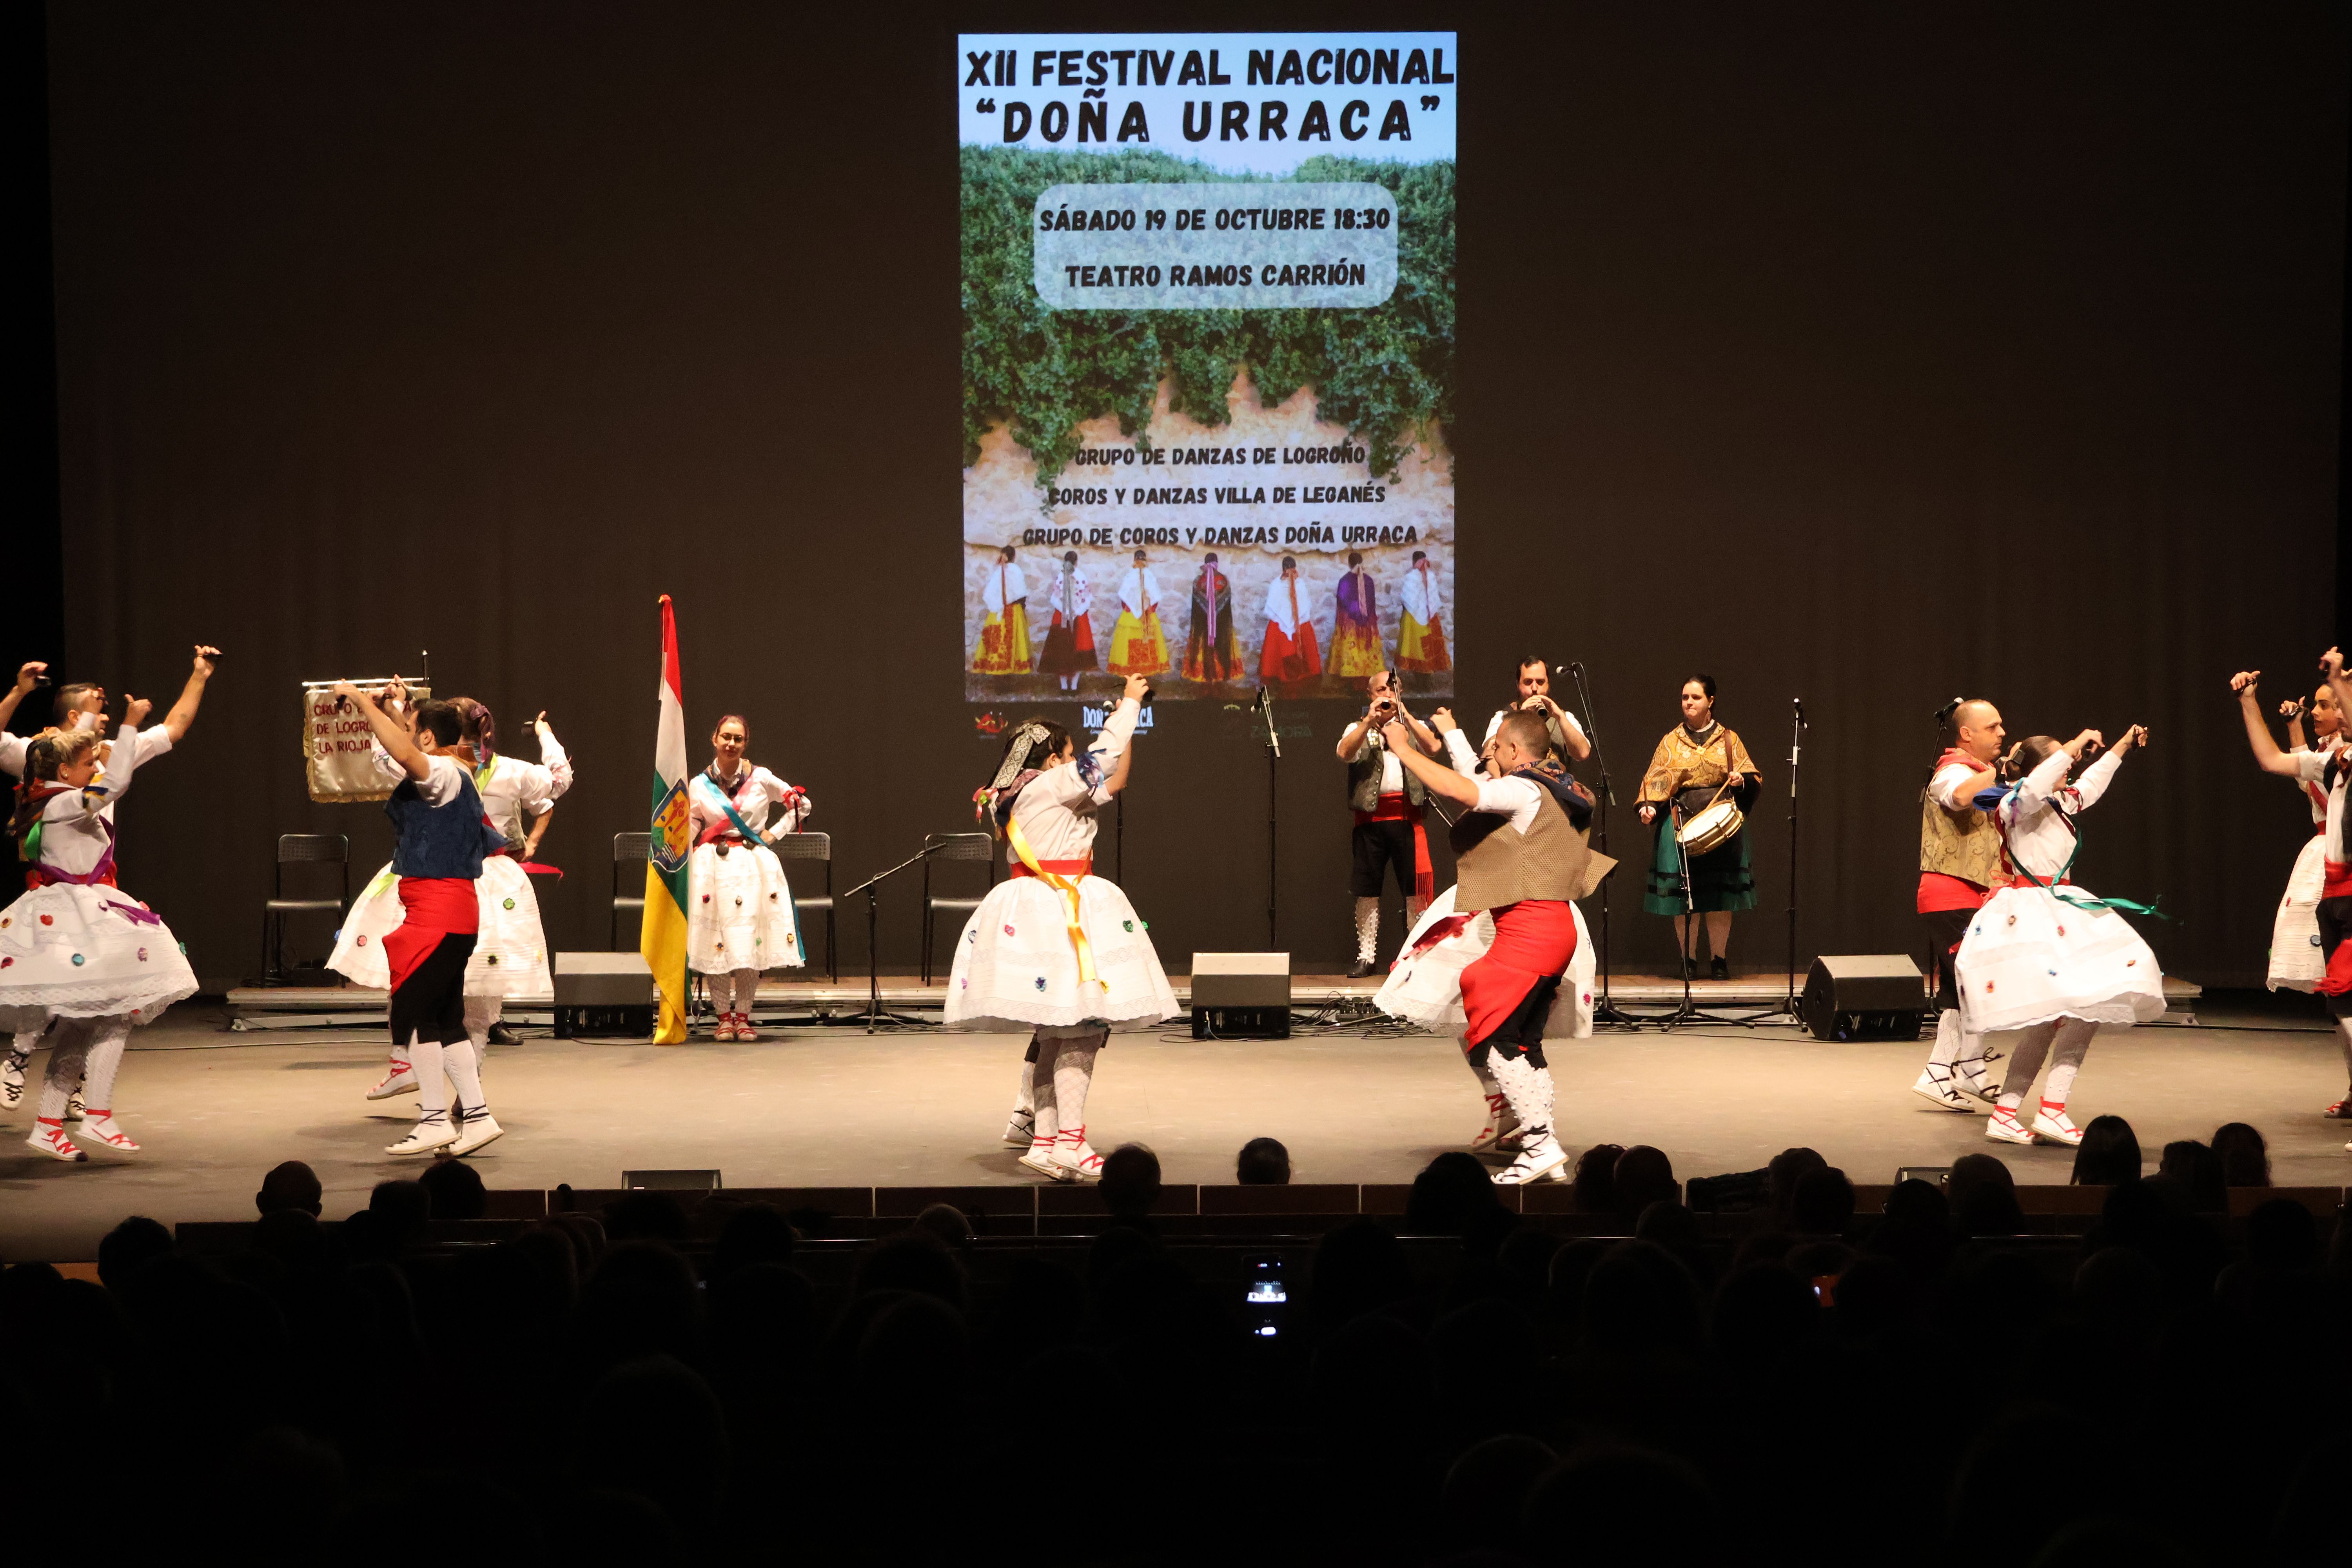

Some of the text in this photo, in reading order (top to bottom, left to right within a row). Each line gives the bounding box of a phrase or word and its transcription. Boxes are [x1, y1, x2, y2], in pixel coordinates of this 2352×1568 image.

[965, 48, 1454, 86] XII FESTIVAL NACIONAL
[976, 89, 1440, 143] “DOÑA URRACA”
[1040, 204, 1390, 231] SÁBADO 19 DE OCTUBRE 18:30
[1065, 258, 1365, 287] TEATRO RAMOS CARRIÓN
[1074, 442, 1365, 466] GRUPO DE DANZAS DE LOGROÑO
[1047, 481, 1385, 506] COROS Y DANZAS VILLA DE LEGANÉS
[1023, 522, 1417, 546] GRUPO DE COROS Y DANZAS DOÑA URRACA
[314, 703, 352, 717] GRUO
[317, 723, 329, 734] DE
[319, 739, 371, 753] LA RIOJA
